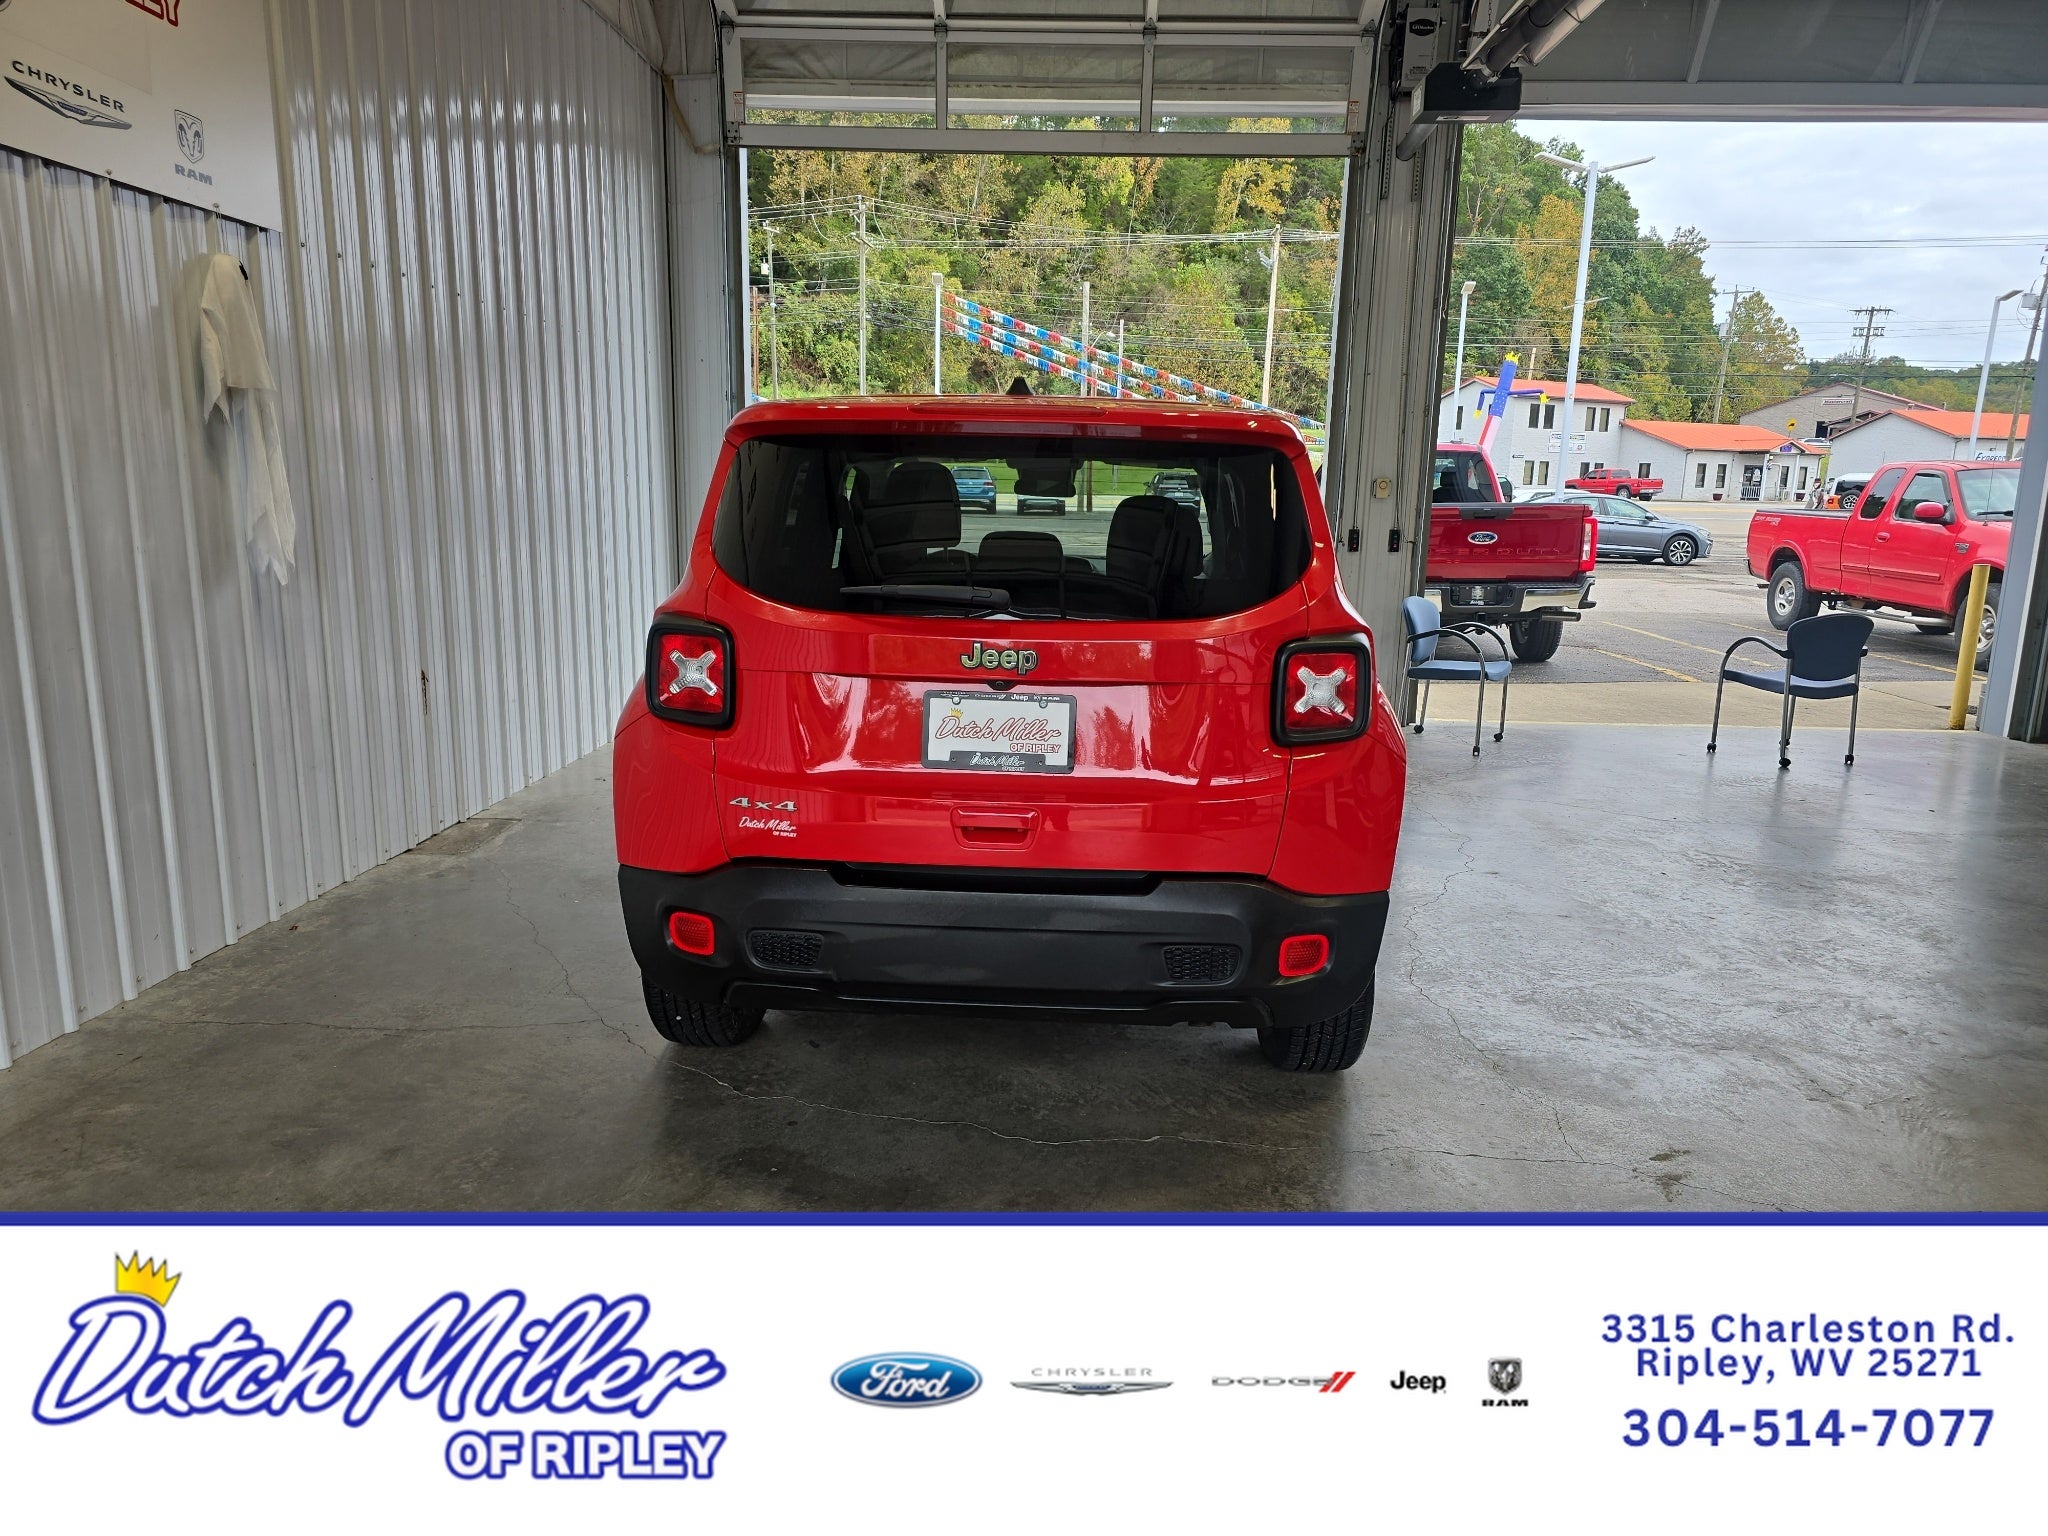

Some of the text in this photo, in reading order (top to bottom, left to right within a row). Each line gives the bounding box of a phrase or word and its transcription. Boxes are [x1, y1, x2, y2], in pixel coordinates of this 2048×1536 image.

[12, 60, 125, 113] CHRYSLER
[174, 163, 213, 186] RAM
[960, 641, 1038, 675] Jeep
[1011, 693, 1029, 702] Jeep
[935, 715, 1062, 742] Dutch Miller
[1010, 743, 1061, 753] OF RIPLEY
[729, 797, 798, 812] 4x4
[739, 816, 797, 831] Dutch Miller
